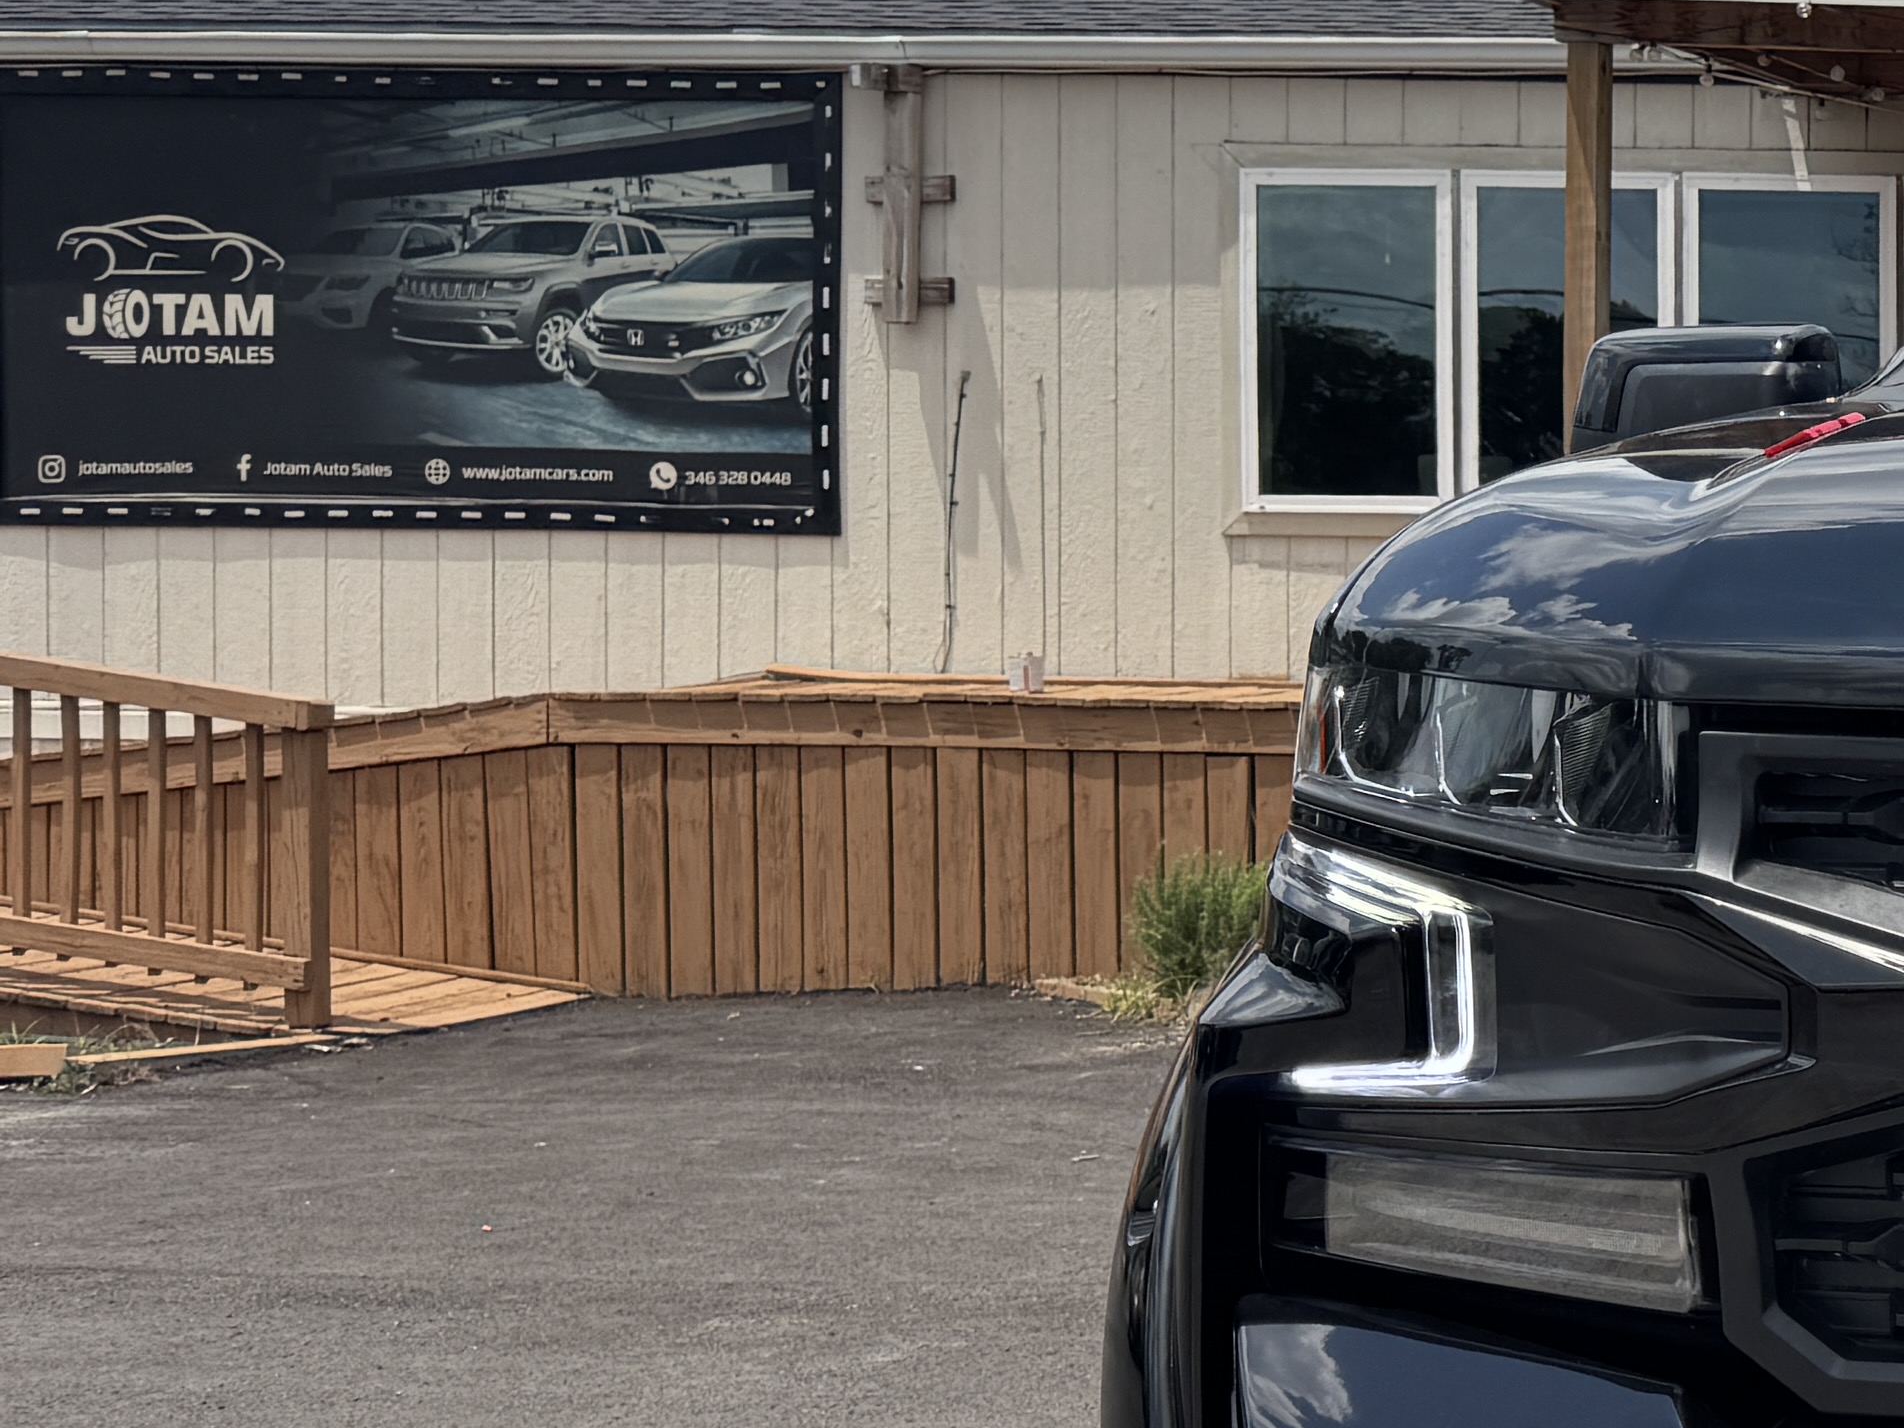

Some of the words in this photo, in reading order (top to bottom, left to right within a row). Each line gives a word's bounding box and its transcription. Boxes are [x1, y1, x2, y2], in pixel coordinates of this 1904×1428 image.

[65, 287, 275, 340] JOTAM
[141, 345, 201, 364] AUTO
[204, 346, 275, 365] SALES
[77, 459, 194, 476] jotamautosales
[263, 461, 310, 477] Jotam
[312, 462, 349, 477] Auto
[351, 462, 393, 478] Sales
[462, 465, 614, 483] www.jotamcars.com
[684, 470, 716, 486] 346
[751, 470, 792, 486] 0448
